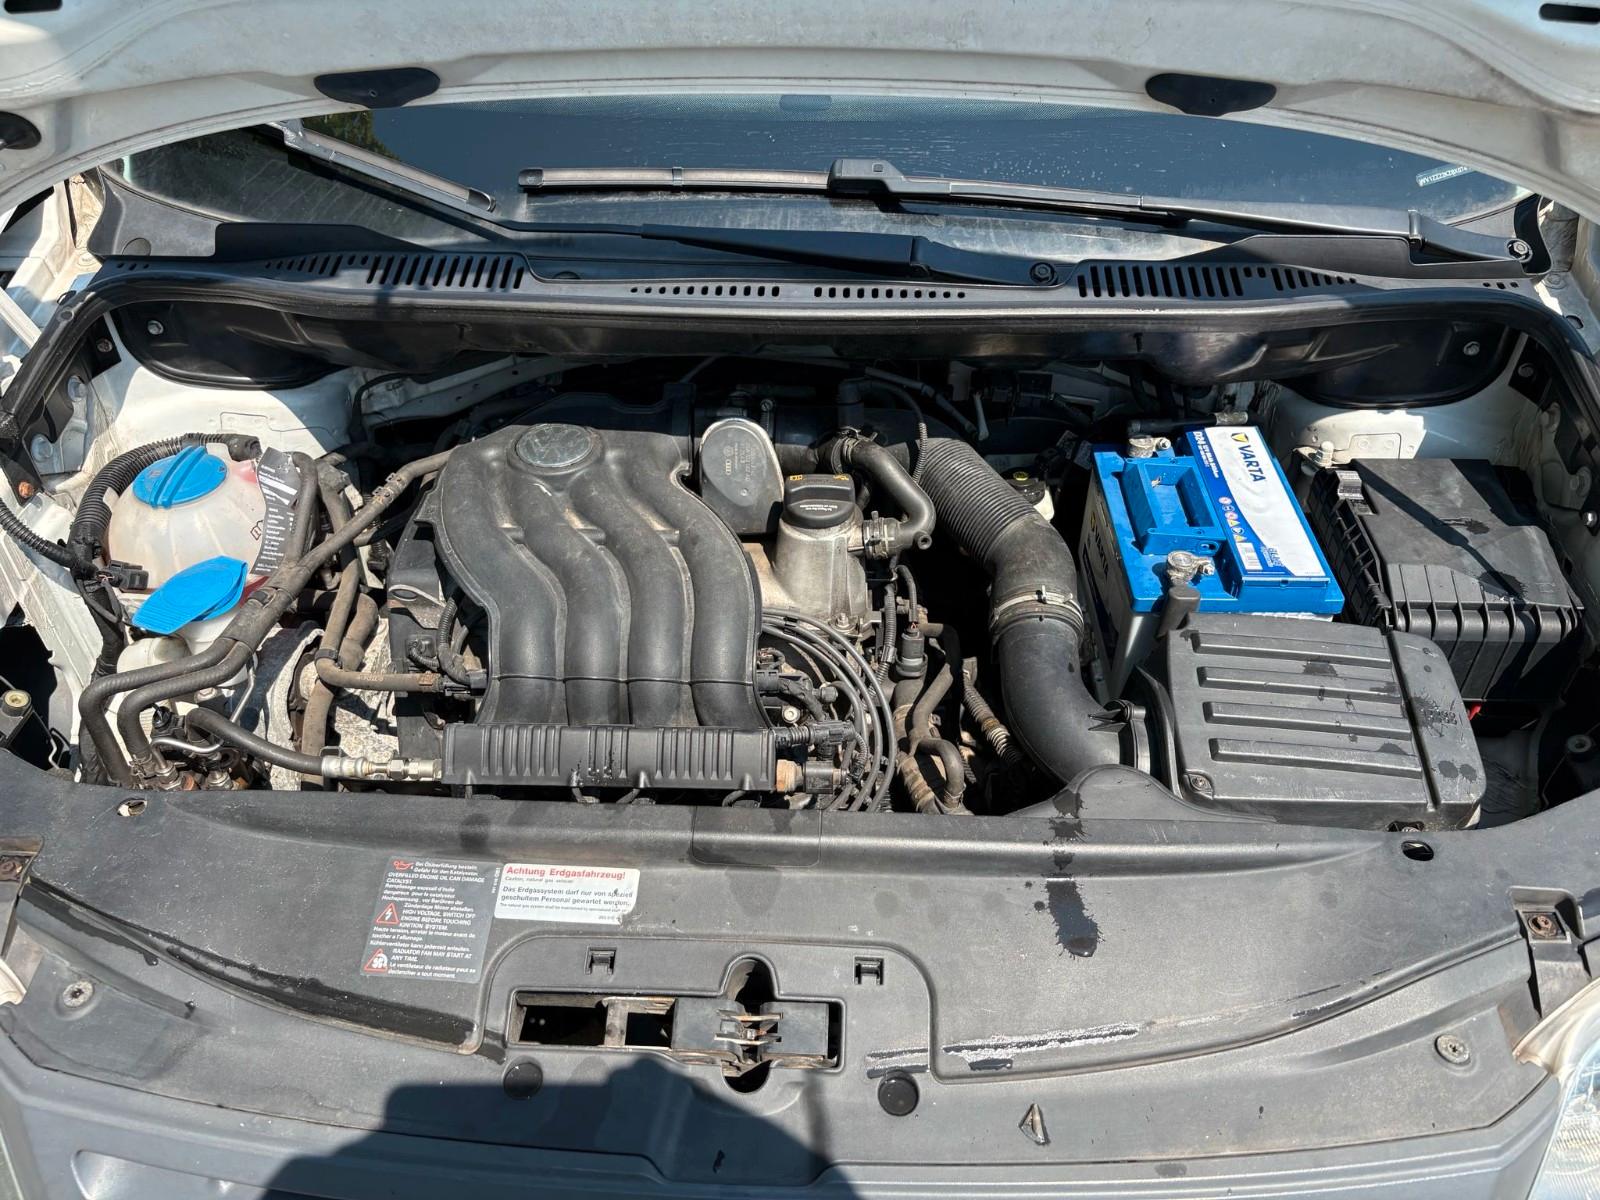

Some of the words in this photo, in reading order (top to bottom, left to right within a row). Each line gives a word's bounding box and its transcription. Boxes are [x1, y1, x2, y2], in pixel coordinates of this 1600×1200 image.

[1238, 444, 1267, 482] VARTA
[506, 866, 545, 878] Achtung
[549, 868, 626, 880] Erdgasfahrzeug!
[517, 886, 564, 895] Erdgassystem
